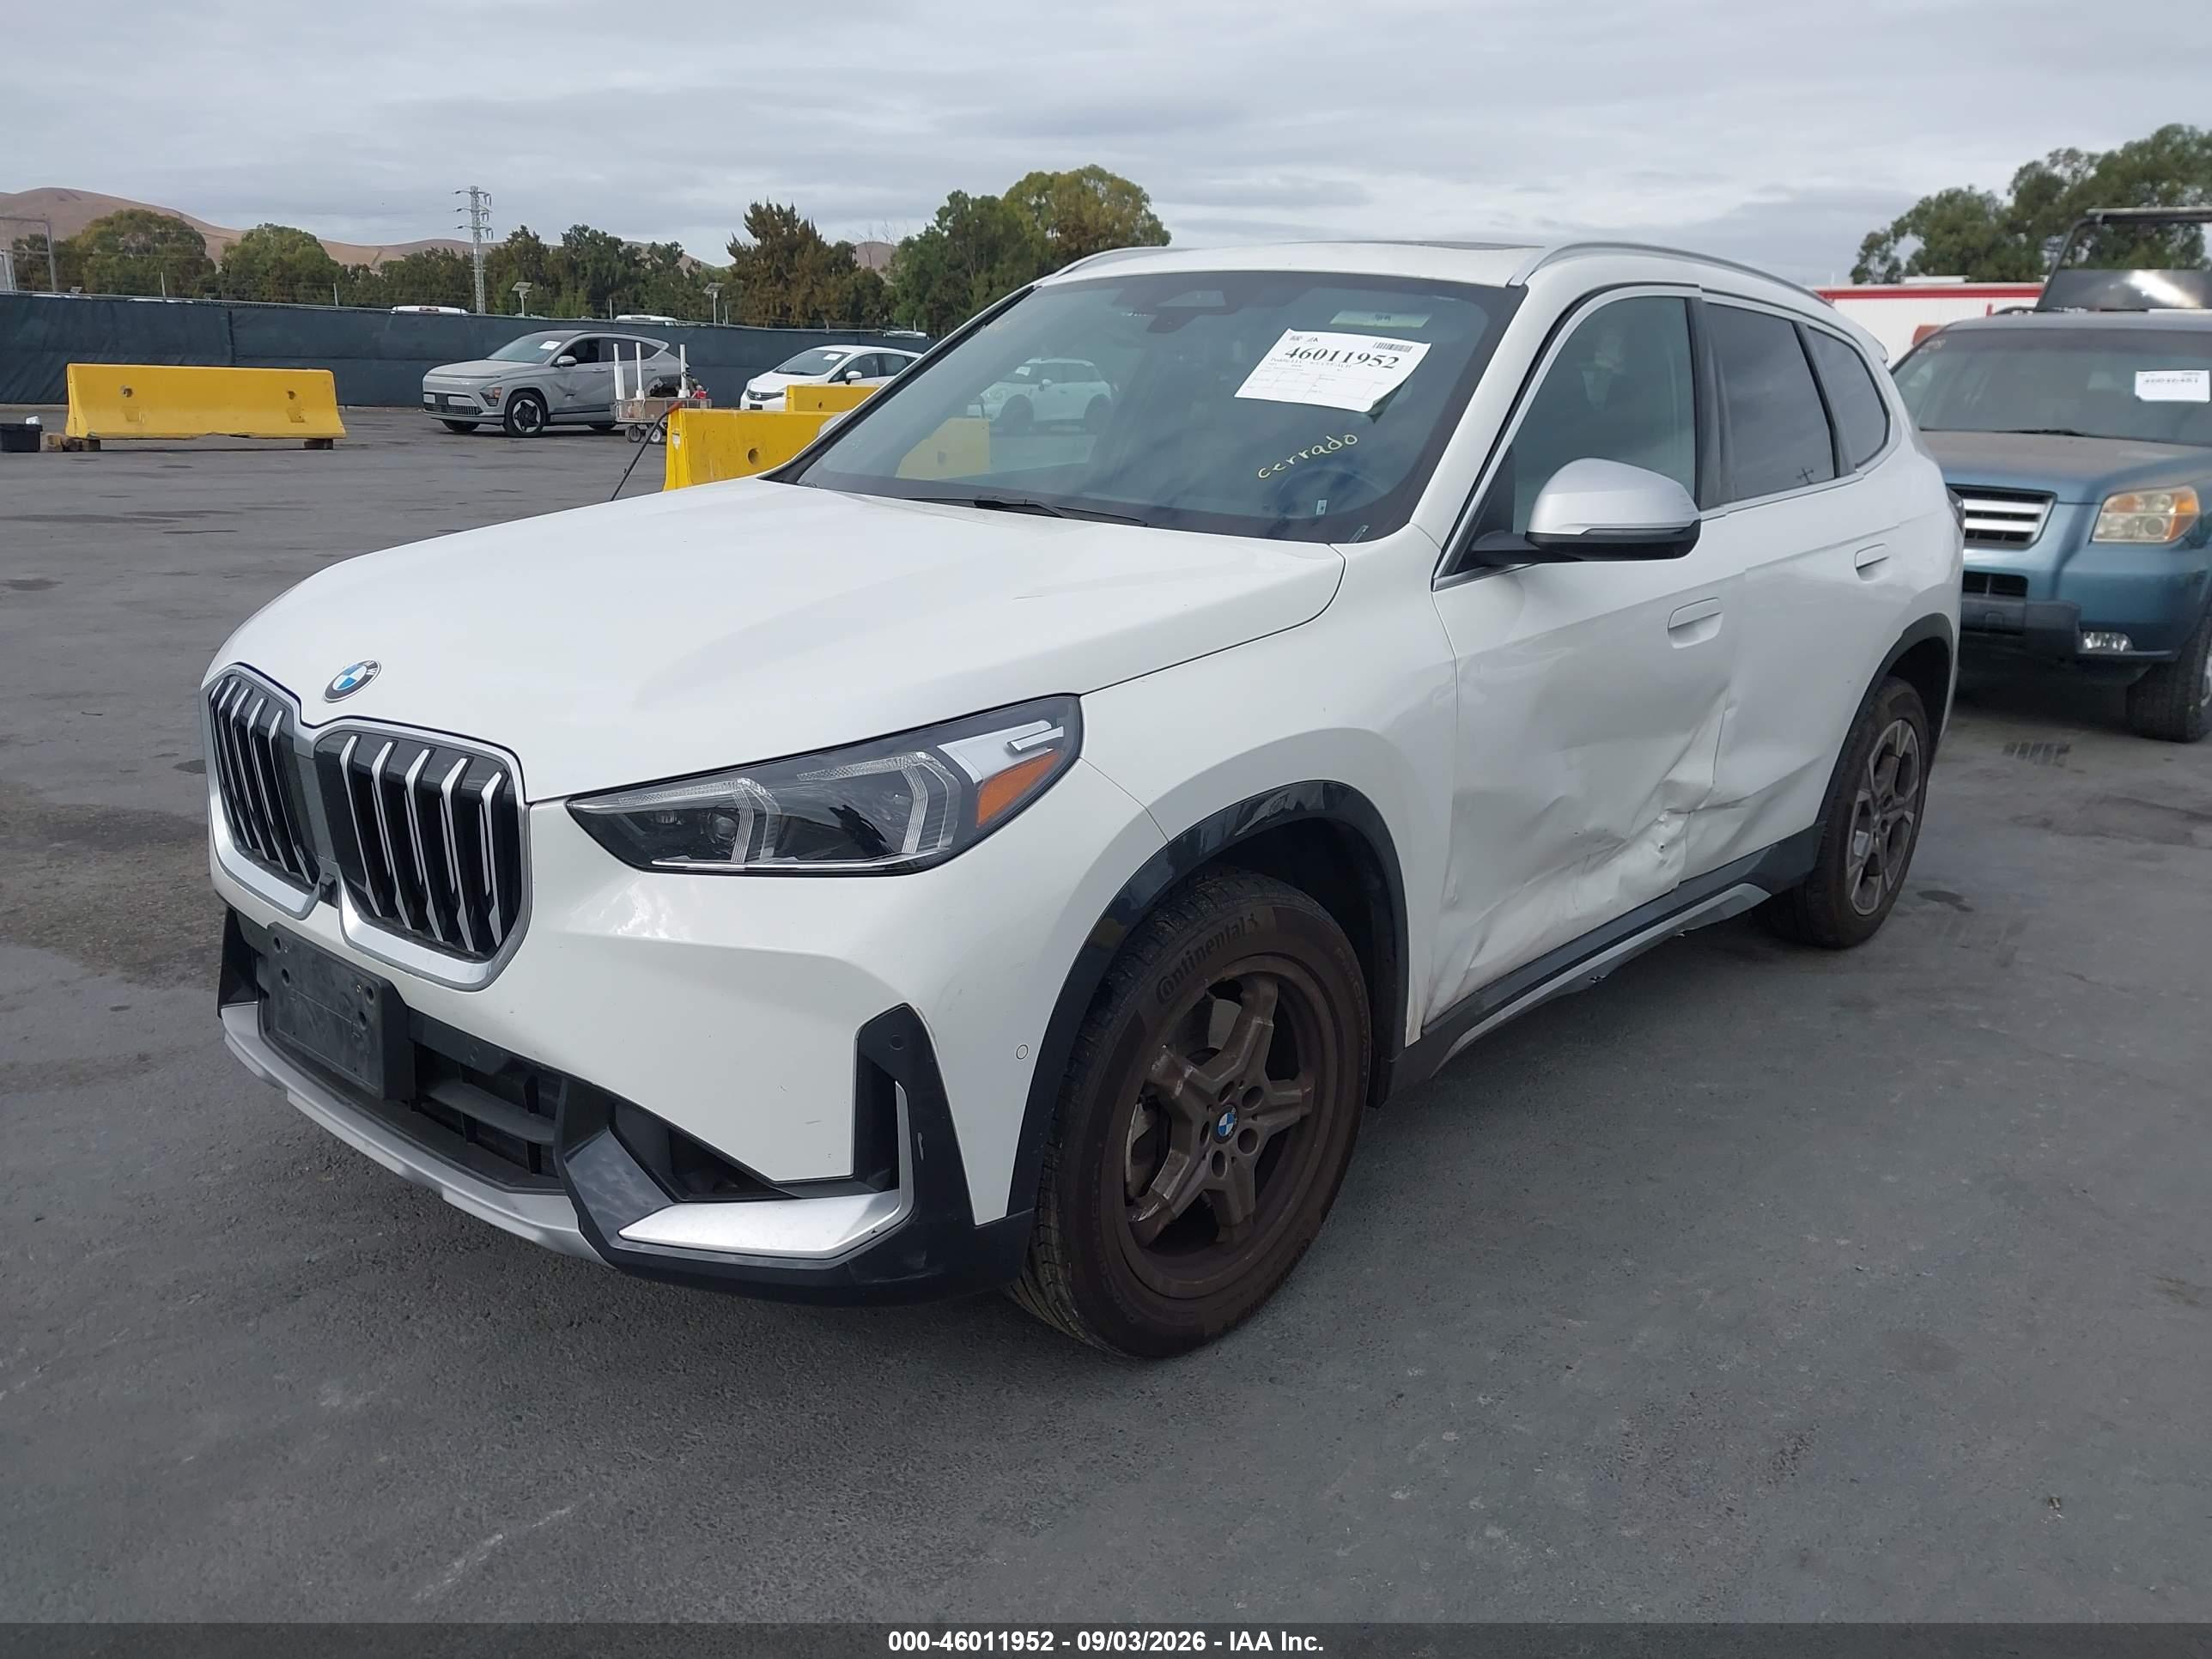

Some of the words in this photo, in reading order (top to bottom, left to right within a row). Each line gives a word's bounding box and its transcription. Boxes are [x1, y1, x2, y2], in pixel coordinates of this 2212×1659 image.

[1285, 346, 1400, 370] 46011952
[1257, 433, 1359, 480] cerrado
[1155, 915, 1247, 1005] Continental
